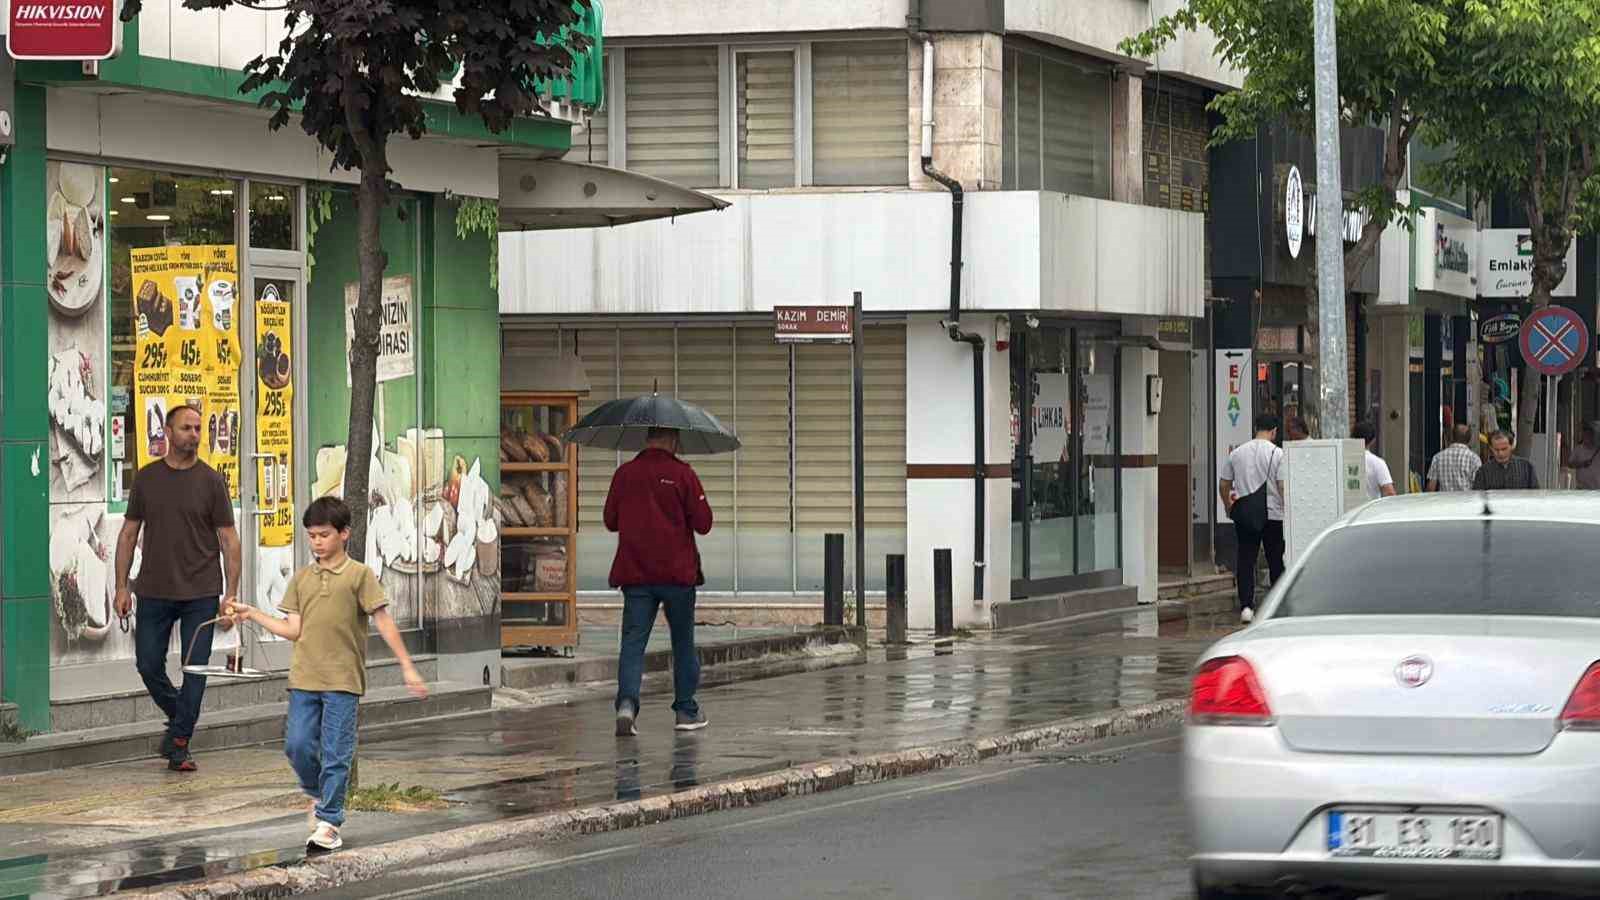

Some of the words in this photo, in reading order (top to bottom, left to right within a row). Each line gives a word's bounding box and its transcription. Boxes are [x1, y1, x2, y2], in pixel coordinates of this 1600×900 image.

[16, 5, 105, 20] HIKVISION
[777, 310, 807, 321] KAZIM
[816, 308, 846, 321] DEMİR
[1228, 364, 1240, 427] ELAY
